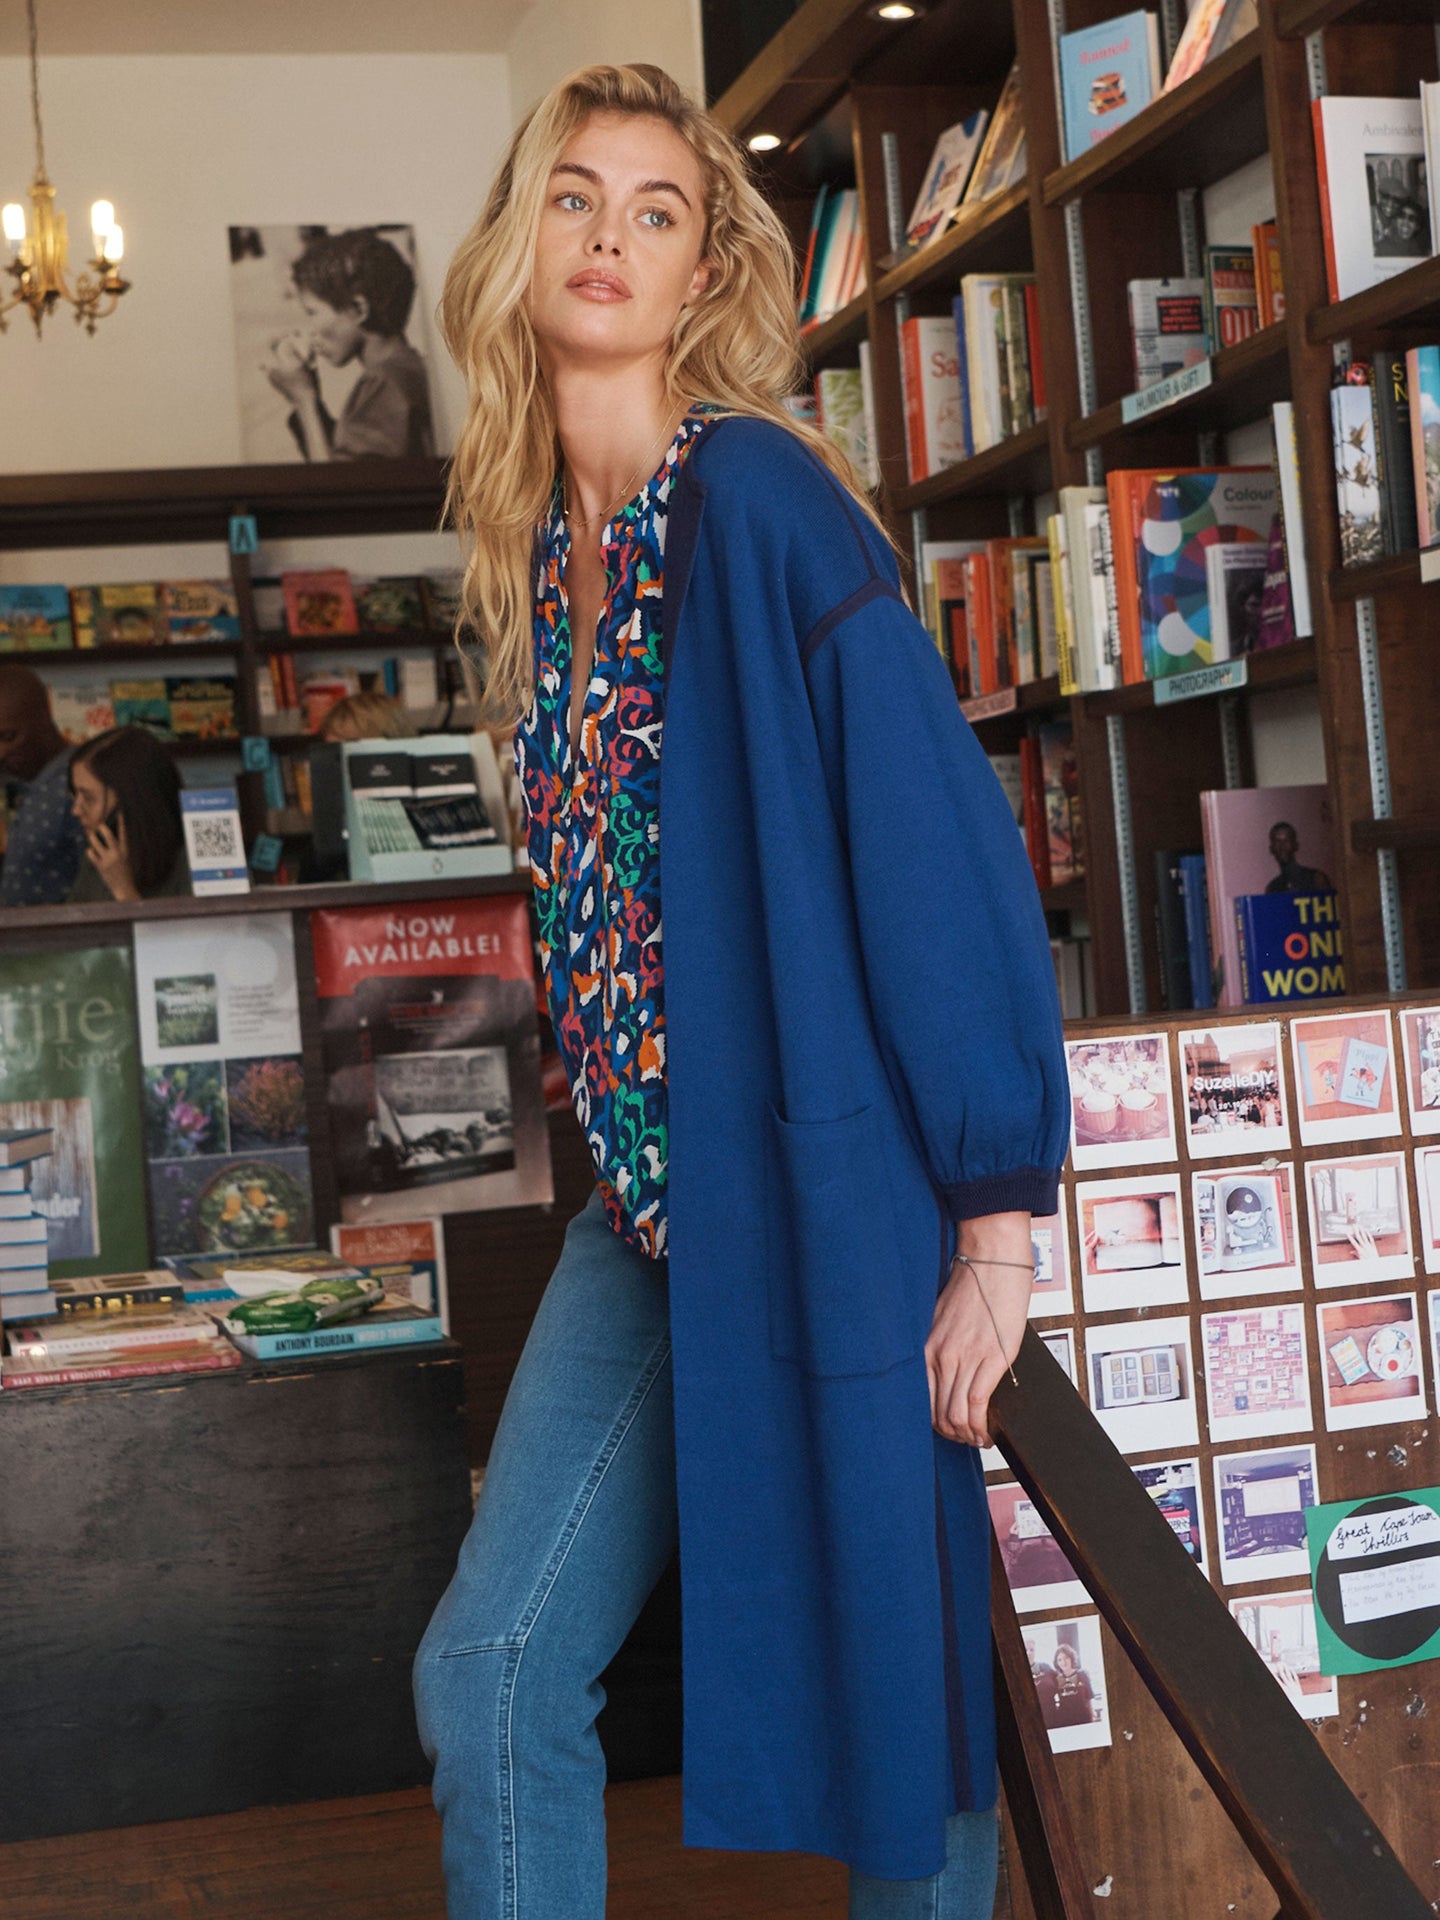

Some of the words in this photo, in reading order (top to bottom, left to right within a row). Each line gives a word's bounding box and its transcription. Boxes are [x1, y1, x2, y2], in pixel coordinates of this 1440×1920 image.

[1136, 385, 1172, 413] HUMOUR
[1181, 368, 1199, 391] GIFT
[1223, 486, 1275, 502] Colour
[234, 522, 253, 549] A
[1169, 665, 1233, 697] PHOTOGRAPHY
[1293, 895, 1340, 925] TH
[385, 915, 457, 939] NOW
[344, 933, 501, 967] AVAILABLE!
[1262, 965, 1347, 998] WOM
[1193, 1069, 1275, 1092] SuzelleDIY
[275, 1335, 312, 1351] ANTHONY
[314, 1332, 355, 1348] BOURDAIN
[358, 1328, 385, 1342] WORLD
[387, 1325, 416, 1339] TRAVEL
[1336, 1521, 1371, 1550] Great
[1360, 1531, 1410, 1554] Thrillers
